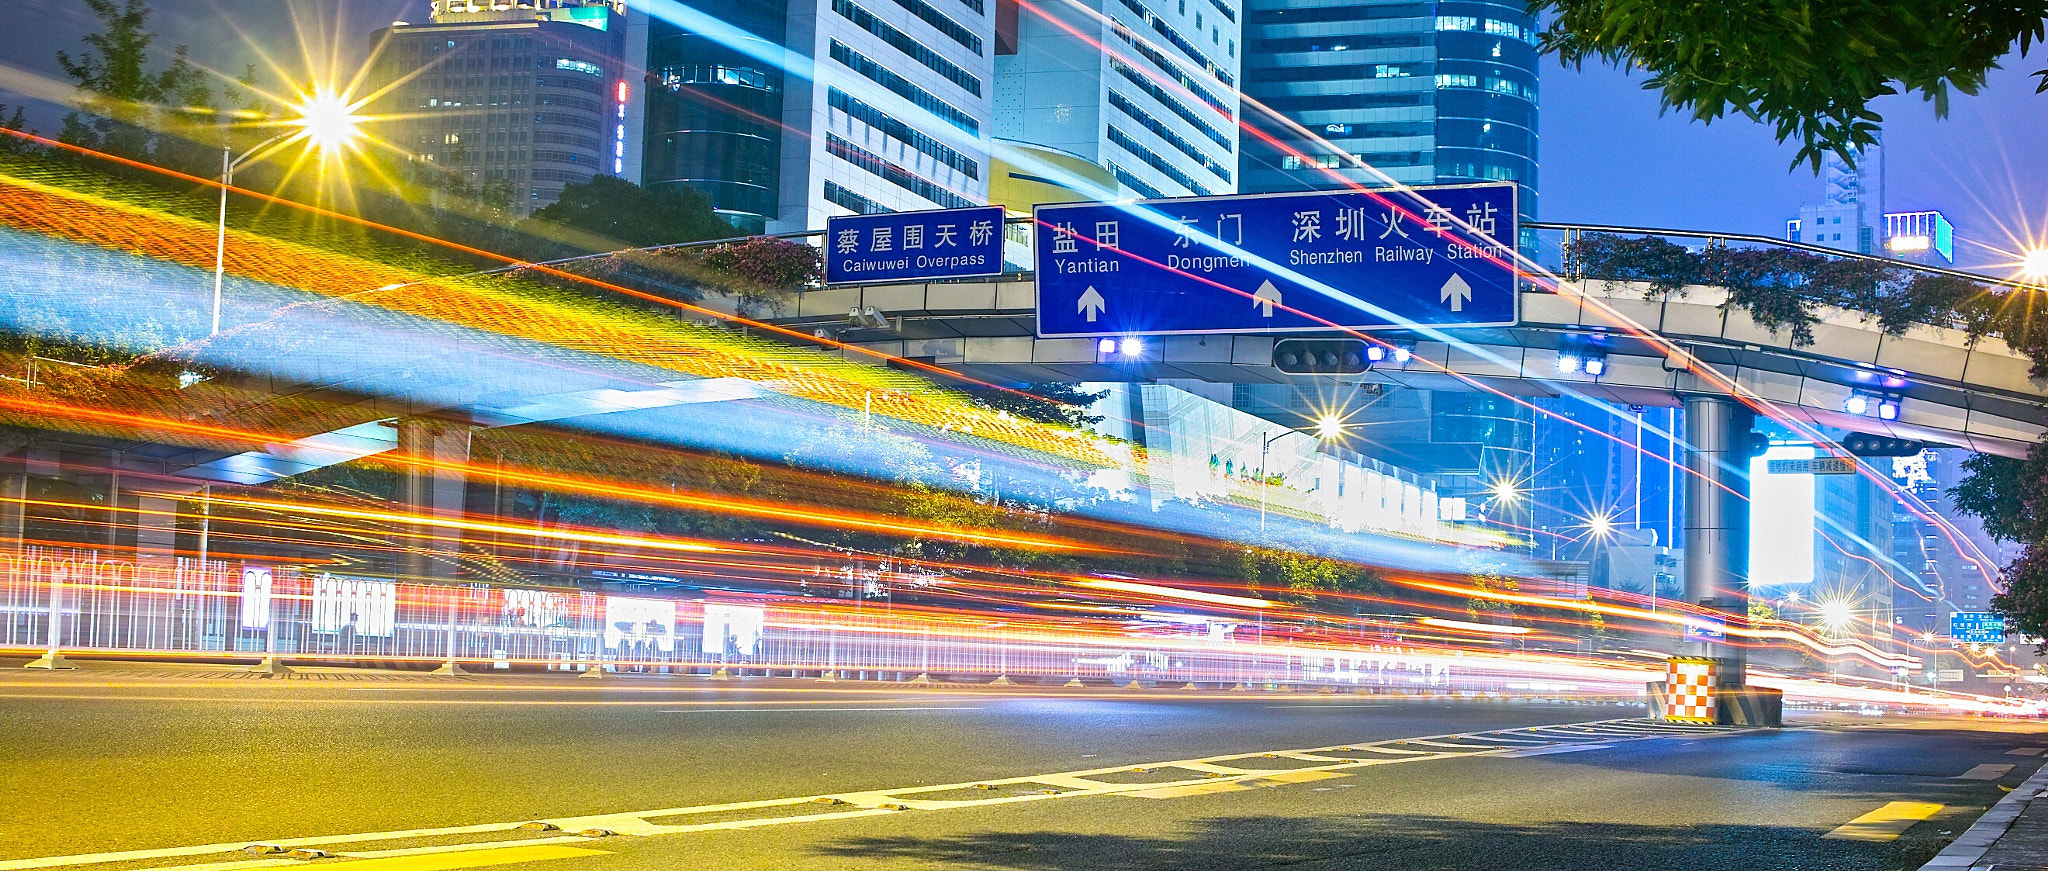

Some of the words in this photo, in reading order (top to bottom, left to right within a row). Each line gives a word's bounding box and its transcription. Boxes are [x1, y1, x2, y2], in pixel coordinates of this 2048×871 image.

[1173, 213, 1243, 249] 东门
[1291, 202, 1498, 243] 深圳火车站
[836, 219, 994, 255] 蔡屋围天桥
[1052, 220, 1119, 254] 盐田
[843, 257, 909, 273] Caiwuwei
[916, 254, 985, 270] Overpass
[1055, 258, 1119, 274] Yantian
[1167, 254, 1250, 272] Dongmen
[1289, 247, 1363, 265] Shenzhen
[1375, 246, 1434, 264] Railway
[1447, 243, 1503, 260] Station
